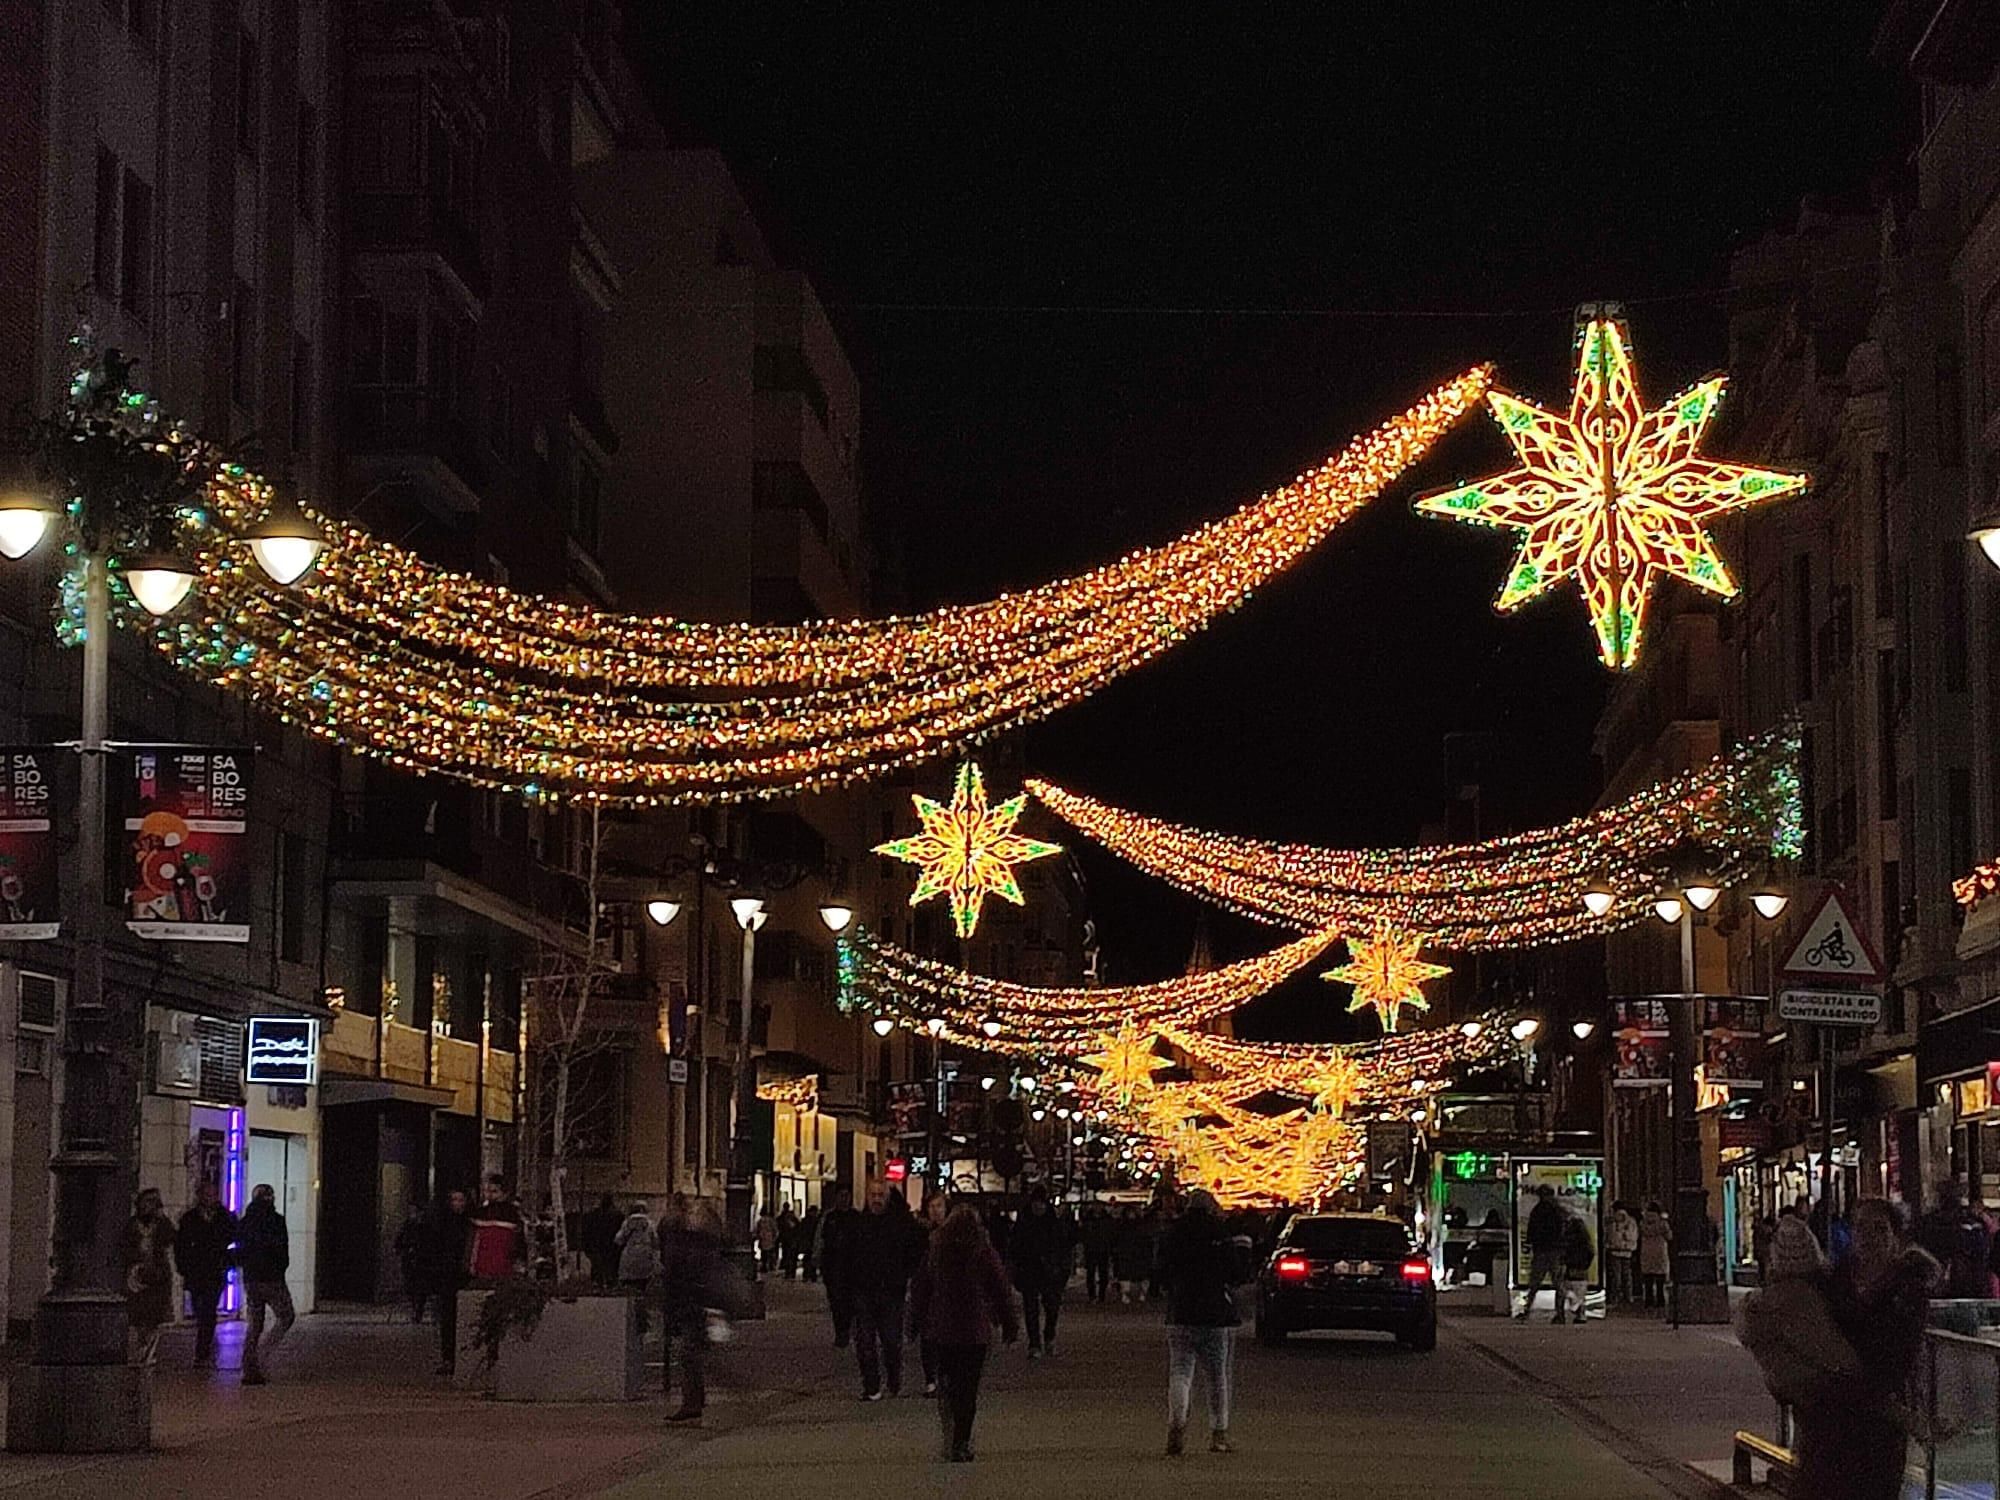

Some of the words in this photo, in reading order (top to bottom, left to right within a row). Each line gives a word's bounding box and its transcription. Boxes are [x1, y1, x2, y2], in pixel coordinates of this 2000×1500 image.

[12, 754, 38, 769] SA
[212, 754, 236, 770] SA
[14, 769, 41, 785] BO
[212, 771, 240, 786] BO
[14, 785, 49, 800] RES
[212, 787, 247, 801] RES
[1787, 995, 1853, 1007] BICICLETAS
[1858, 998, 1875, 1007] EN
[1781, 1006, 1878, 1020] CONTRASENTIDO
